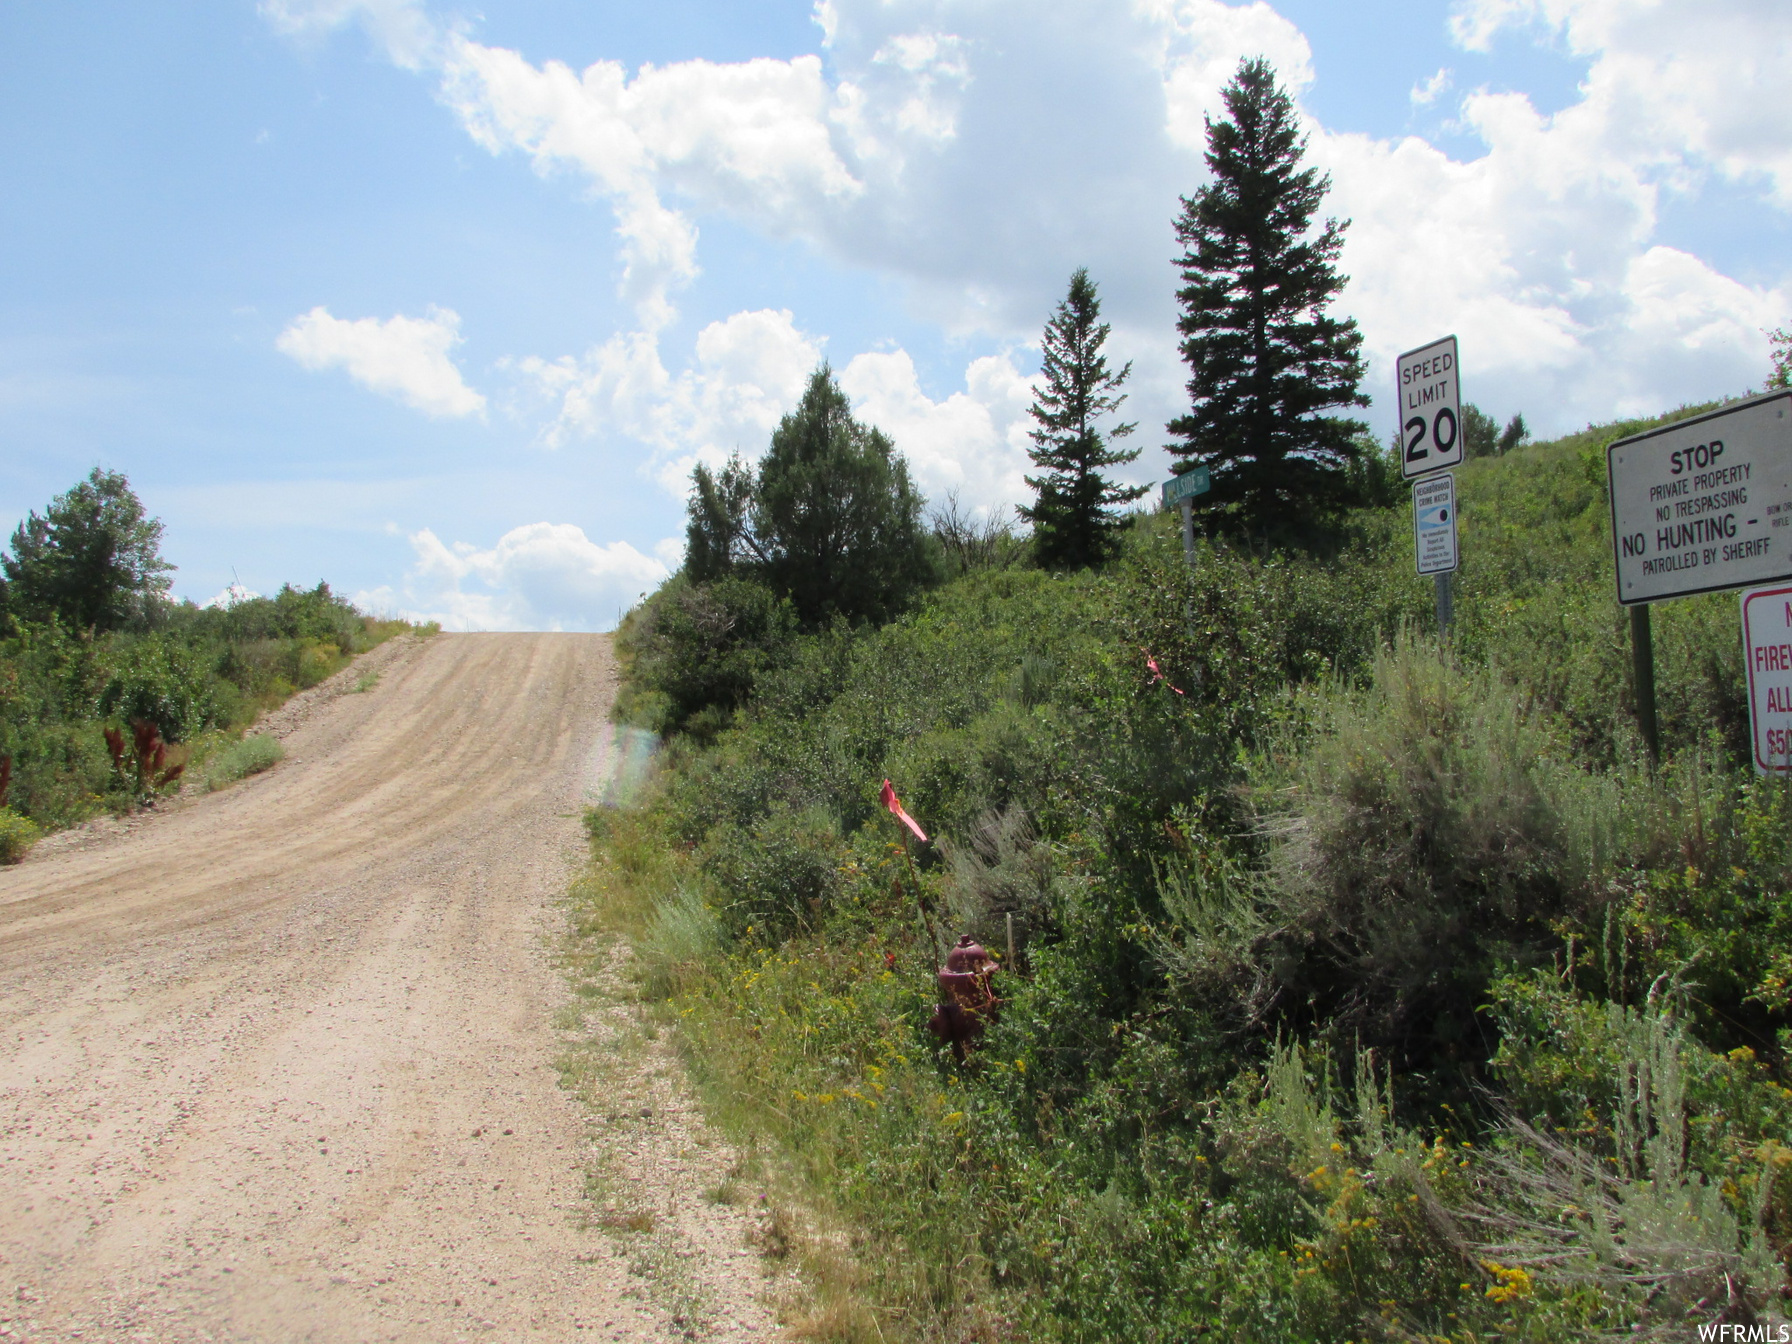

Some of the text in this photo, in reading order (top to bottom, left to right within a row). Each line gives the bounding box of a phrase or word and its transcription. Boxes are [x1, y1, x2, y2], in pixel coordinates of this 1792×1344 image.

[1403, 353, 1453, 385] SPEED
[1408, 380, 1448, 410] LIMIT
[1404, 407, 1457, 463] 20
[1670, 440, 1724, 475] STOP
[1419, 493, 1448, 506] CRIME WATCH
[1650, 462, 1751, 502] PRIVATE PROPERTY
[1656, 487, 1747, 522] NO TRESPASSING
[1771, 516, 1790, 528] RIFLE
[1622, 532, 1646, 558] NO
[1657, 513, 1736, 551] HUNTING
[1642, 537, 1771, 576] PATROLLED BY SHERIFF
